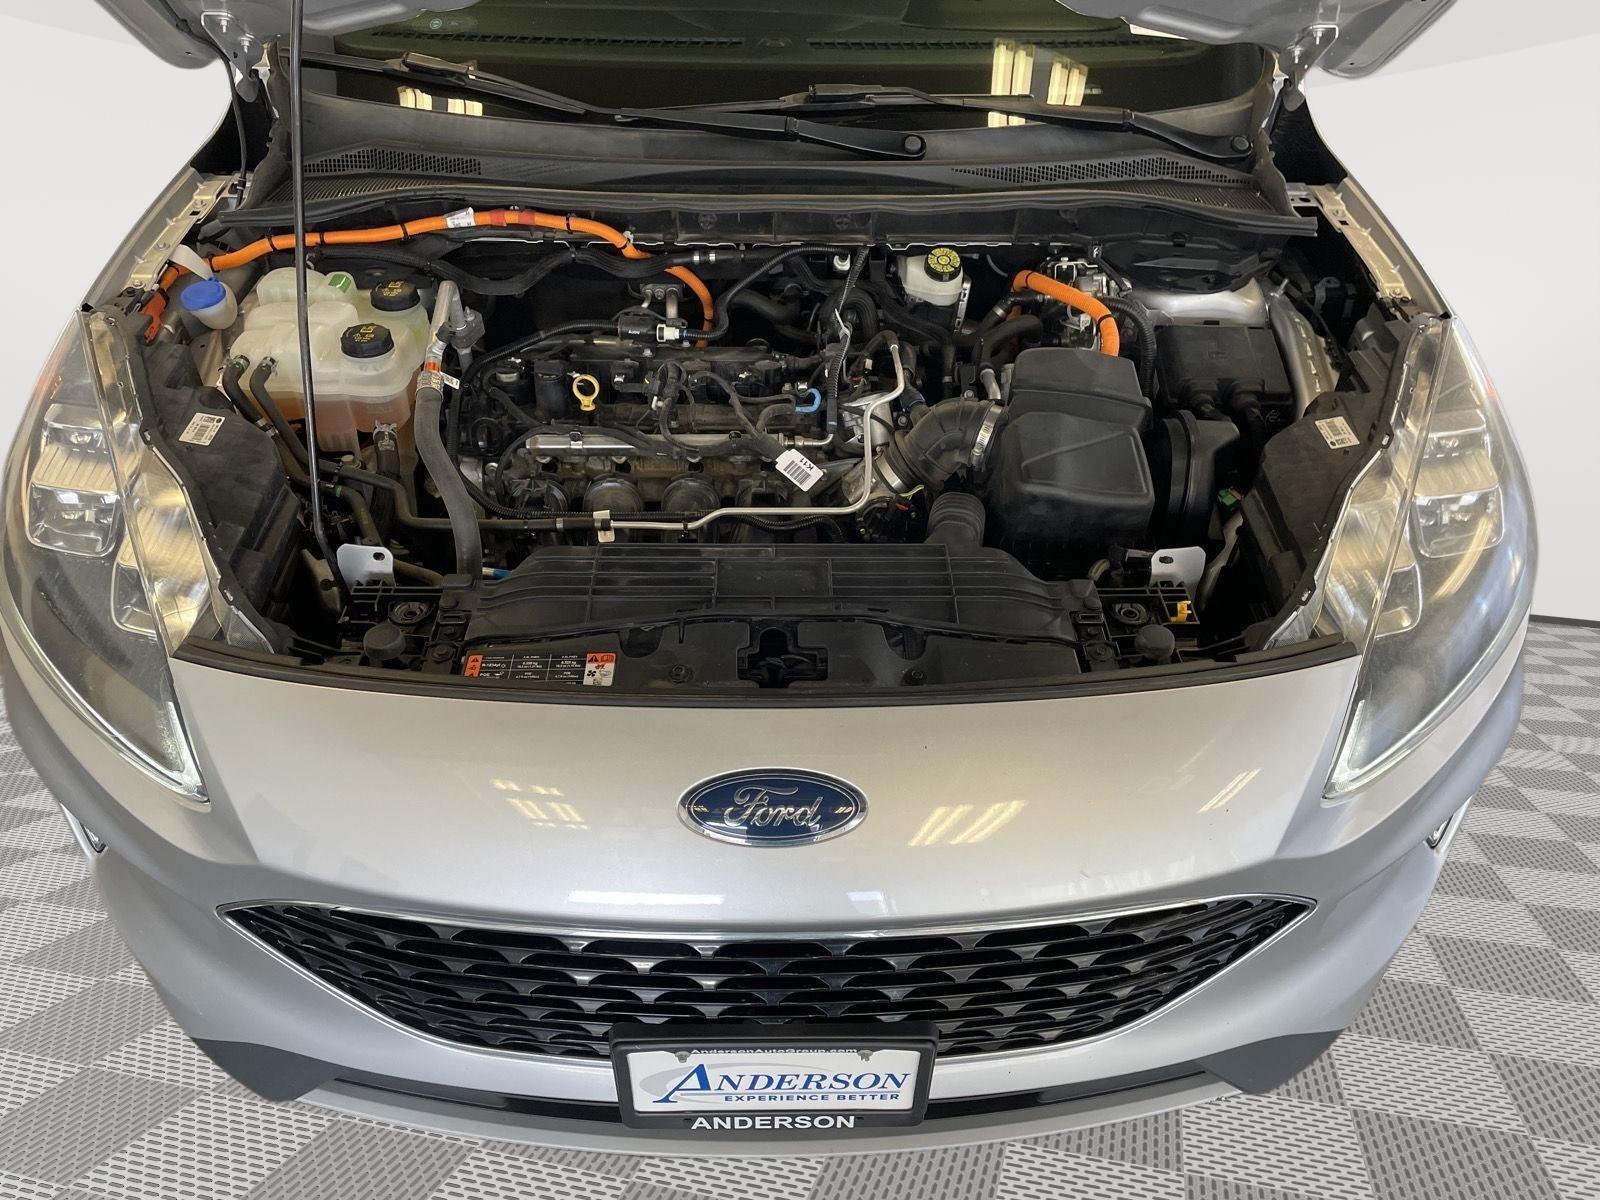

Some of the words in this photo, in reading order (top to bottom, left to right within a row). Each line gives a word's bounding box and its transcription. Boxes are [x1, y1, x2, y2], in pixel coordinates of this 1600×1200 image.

[723, 786, 824, 828] Ford
[653, 1063, 911, 1104] ANDERSON
[724, 1093, 829, 1103] EXPERIENCE
[836, 1092, 900, 1102] BETTER
[690, 1115, 856, 1131] ANDERSON
